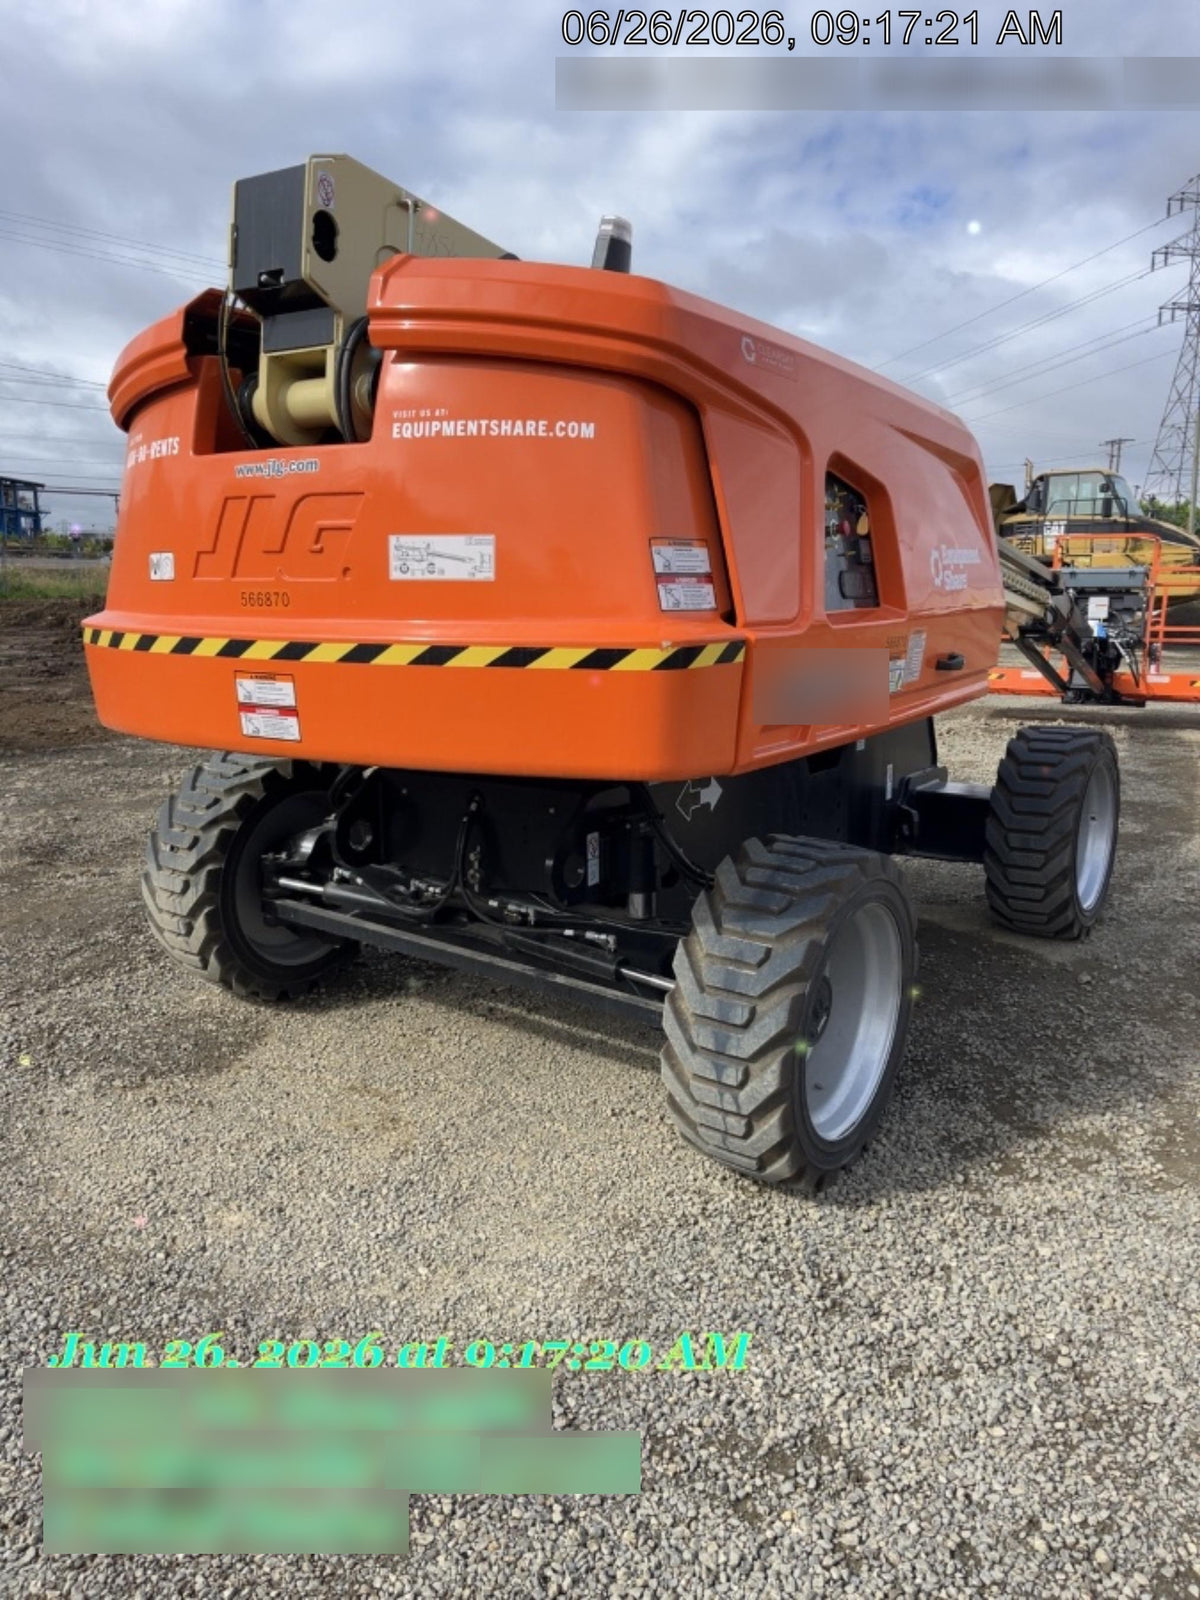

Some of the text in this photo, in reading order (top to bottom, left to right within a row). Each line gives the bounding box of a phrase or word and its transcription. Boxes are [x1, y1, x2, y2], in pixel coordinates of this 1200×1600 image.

[419, 409, 431, 417] US
[392, 419, 596, 439] EQUIPMENTSHARE.COM
[235, 458, 319, 478] www.jlg.com
[240, 591, 290, 608] 566870
